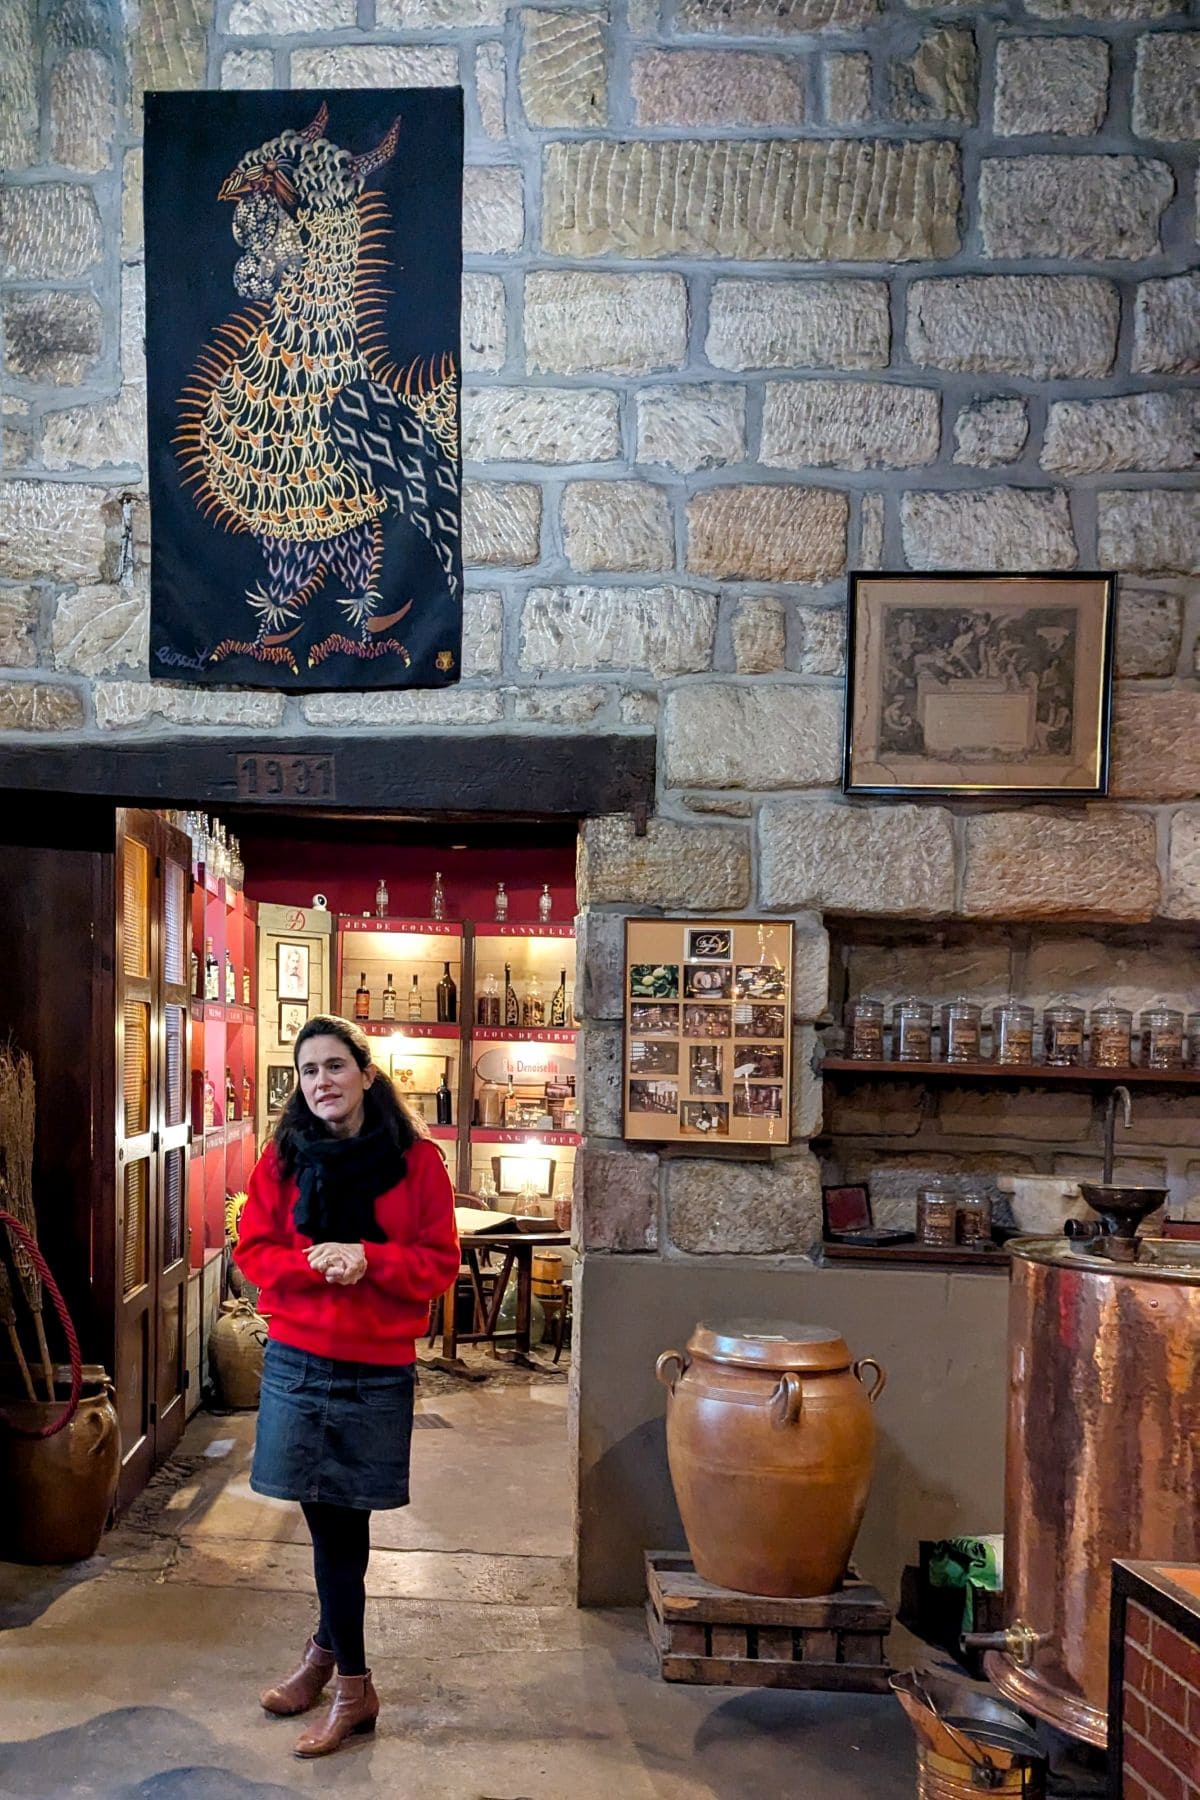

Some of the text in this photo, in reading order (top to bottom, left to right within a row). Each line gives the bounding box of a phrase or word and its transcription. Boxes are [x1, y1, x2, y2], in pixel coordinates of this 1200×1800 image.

[241, 758, 330, 794] 1931
[345, 921, 451, 933] JUS DE COINGS
[500, 927, 577, 937] CANNELLE
[475, 1031, 514, 1039] CLOUS
[518, 1032, 533, 1040] DE
